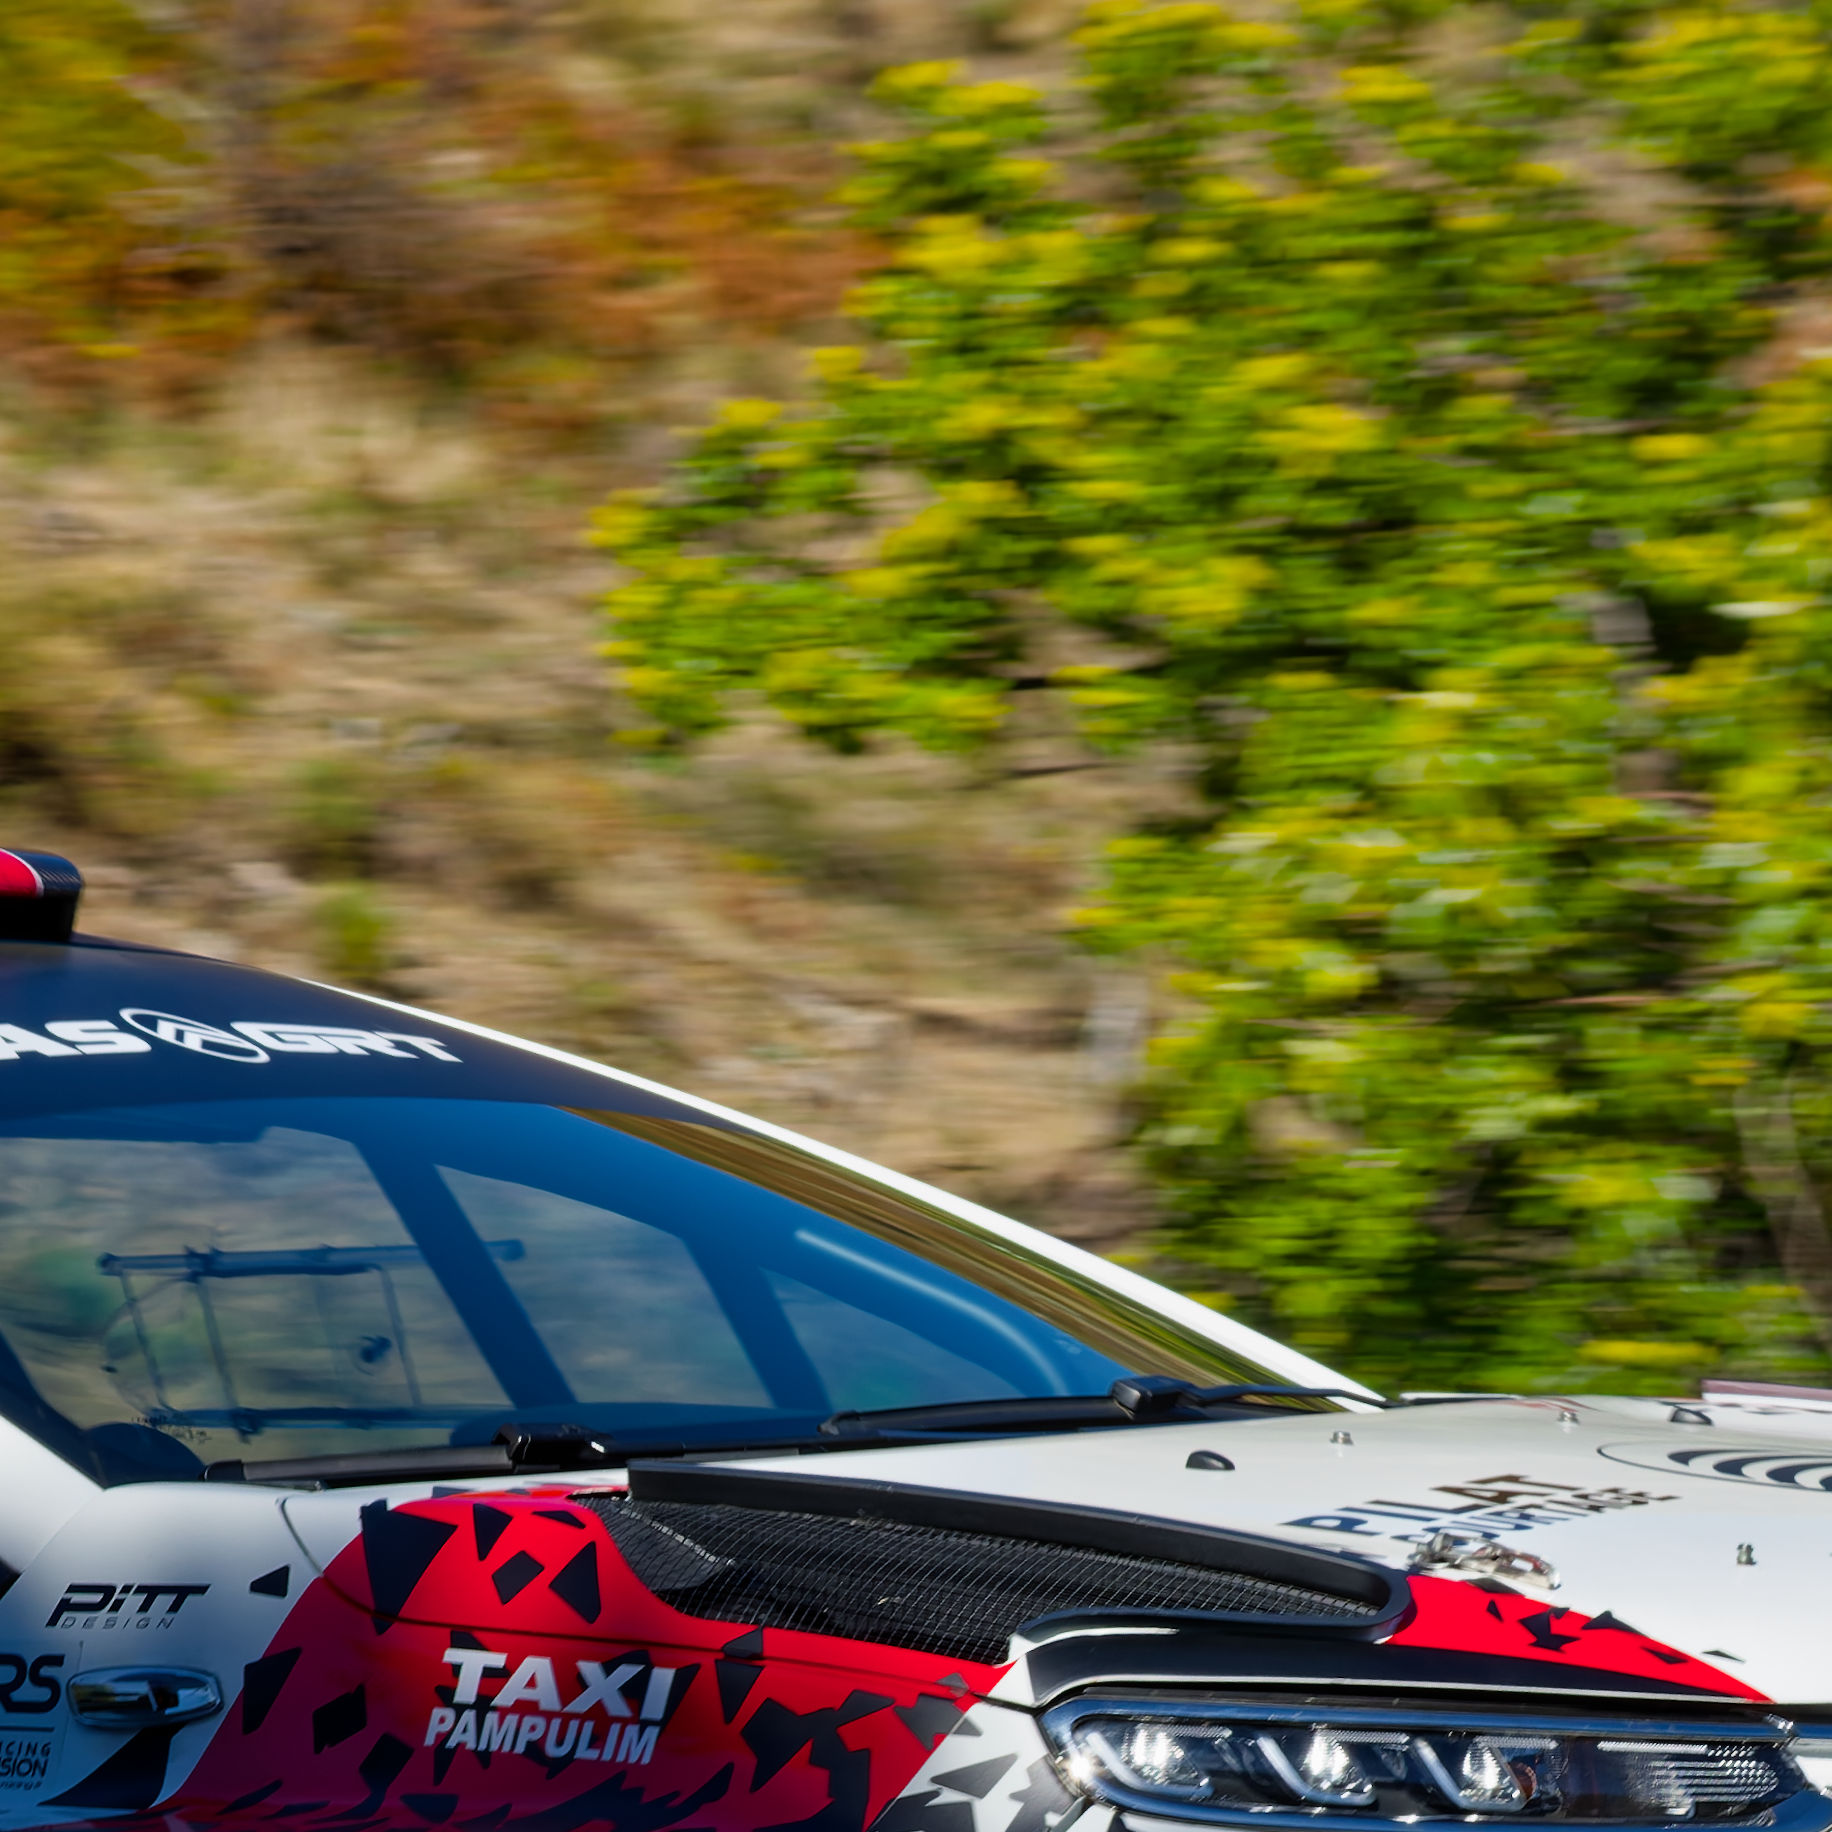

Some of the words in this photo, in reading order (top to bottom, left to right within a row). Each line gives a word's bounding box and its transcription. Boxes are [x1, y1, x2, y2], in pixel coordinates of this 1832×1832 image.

[231, 1021, 464, 1063] GRT
[1280, 1474, 1580, 1536] PILAT
[60, 1617, 174, 1630] DESIGN
[442, 1648, 677, 1722] TAXI
[424, 1706, 661, 1766] PAMPULIM
